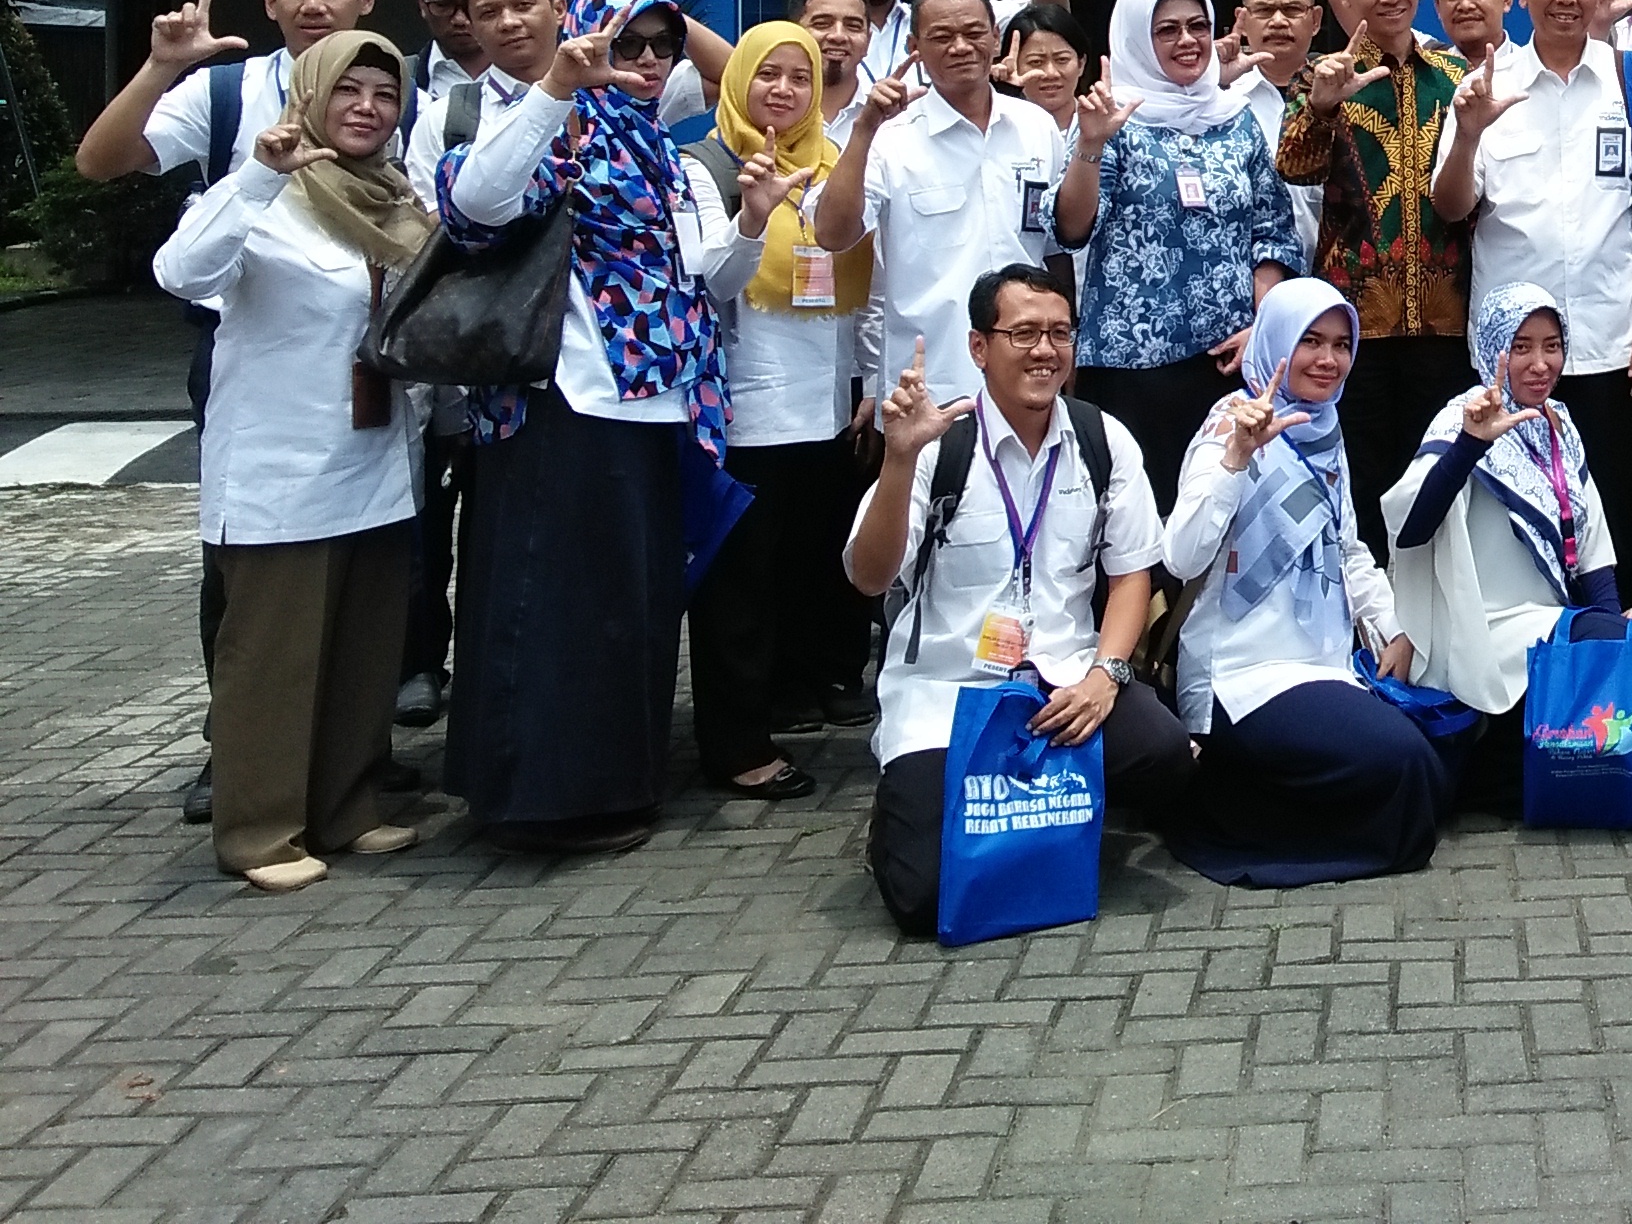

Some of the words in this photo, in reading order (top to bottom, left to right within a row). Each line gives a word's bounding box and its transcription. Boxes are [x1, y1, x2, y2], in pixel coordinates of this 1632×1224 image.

[963, 773, 1010, 800] AYO
[963, 802, 996, 818] JAGA
[997, 798, 1046, 817] BAHASA
[1048, 792, 1092, 809] NEGARA
[964, 817, 1009, 834] REKAT
